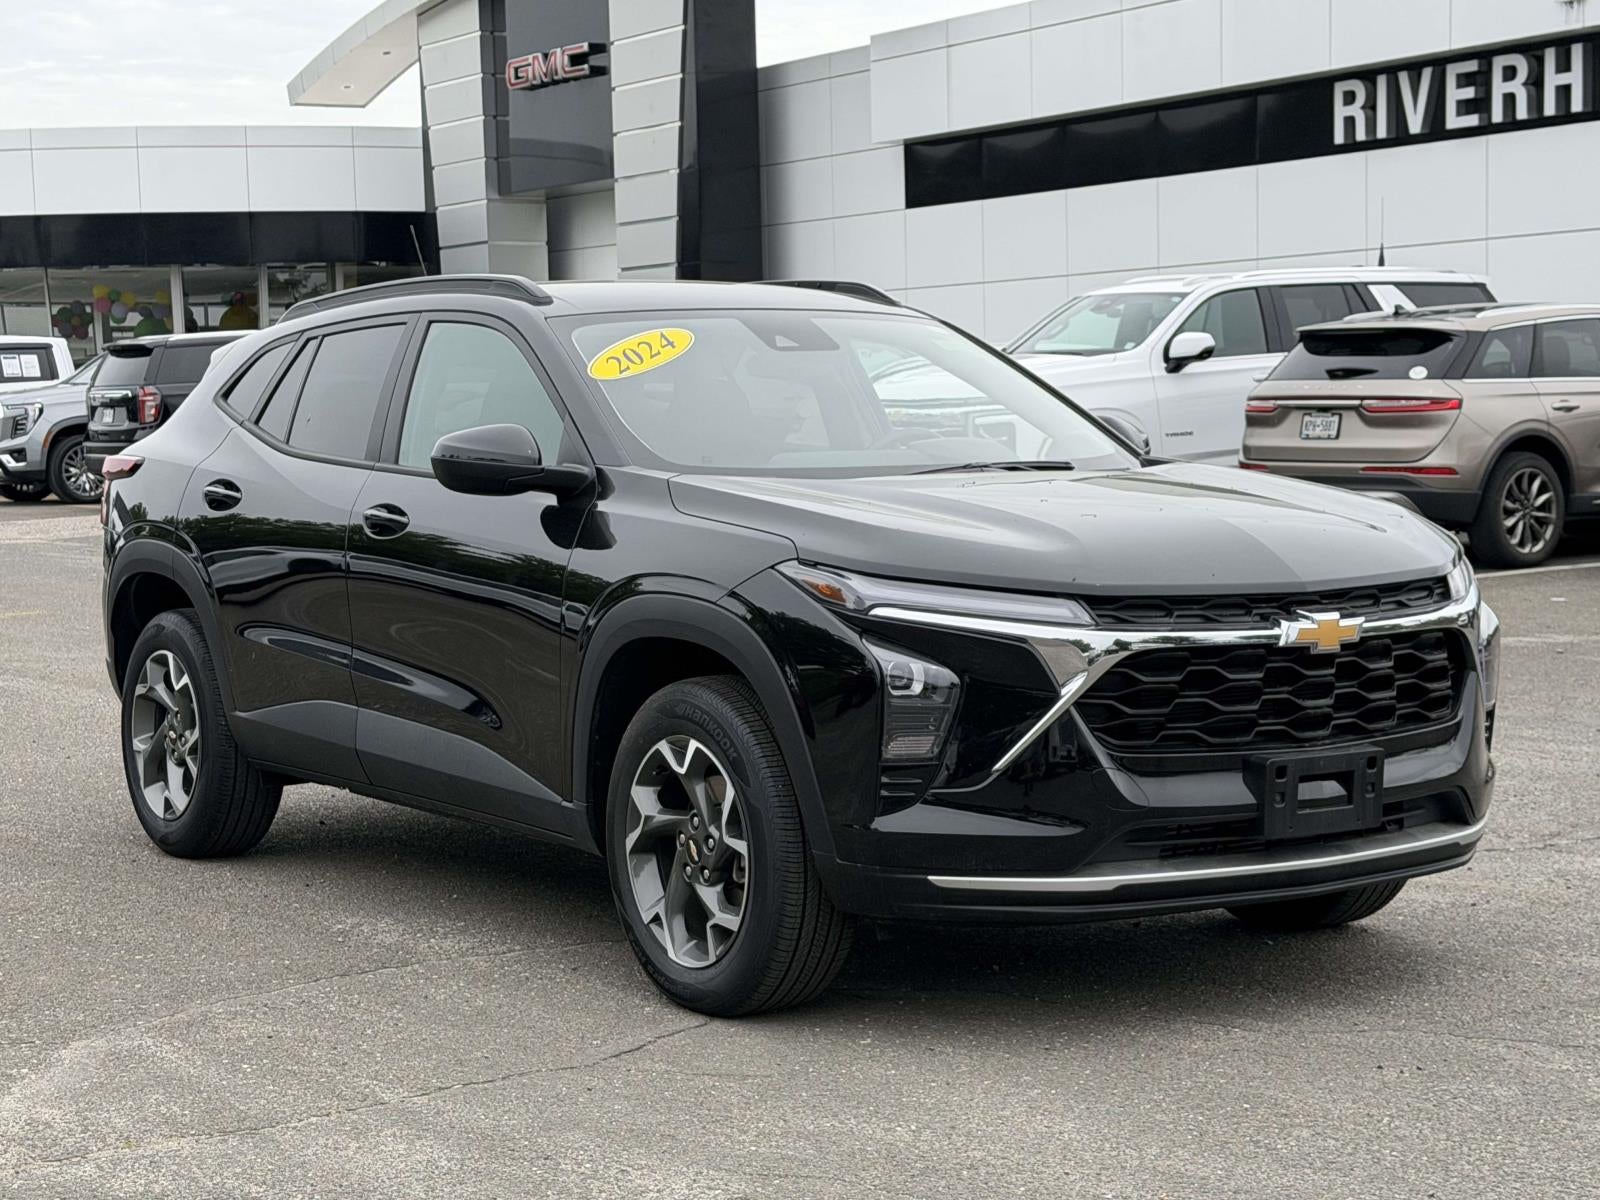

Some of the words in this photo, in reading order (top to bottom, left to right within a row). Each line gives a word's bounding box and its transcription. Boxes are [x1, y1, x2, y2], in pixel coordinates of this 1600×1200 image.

[505, 42, 589, 89] GMC
[1333, 42, 1583, 145] RIVERH
[606, 331, 677, 375] 2024
